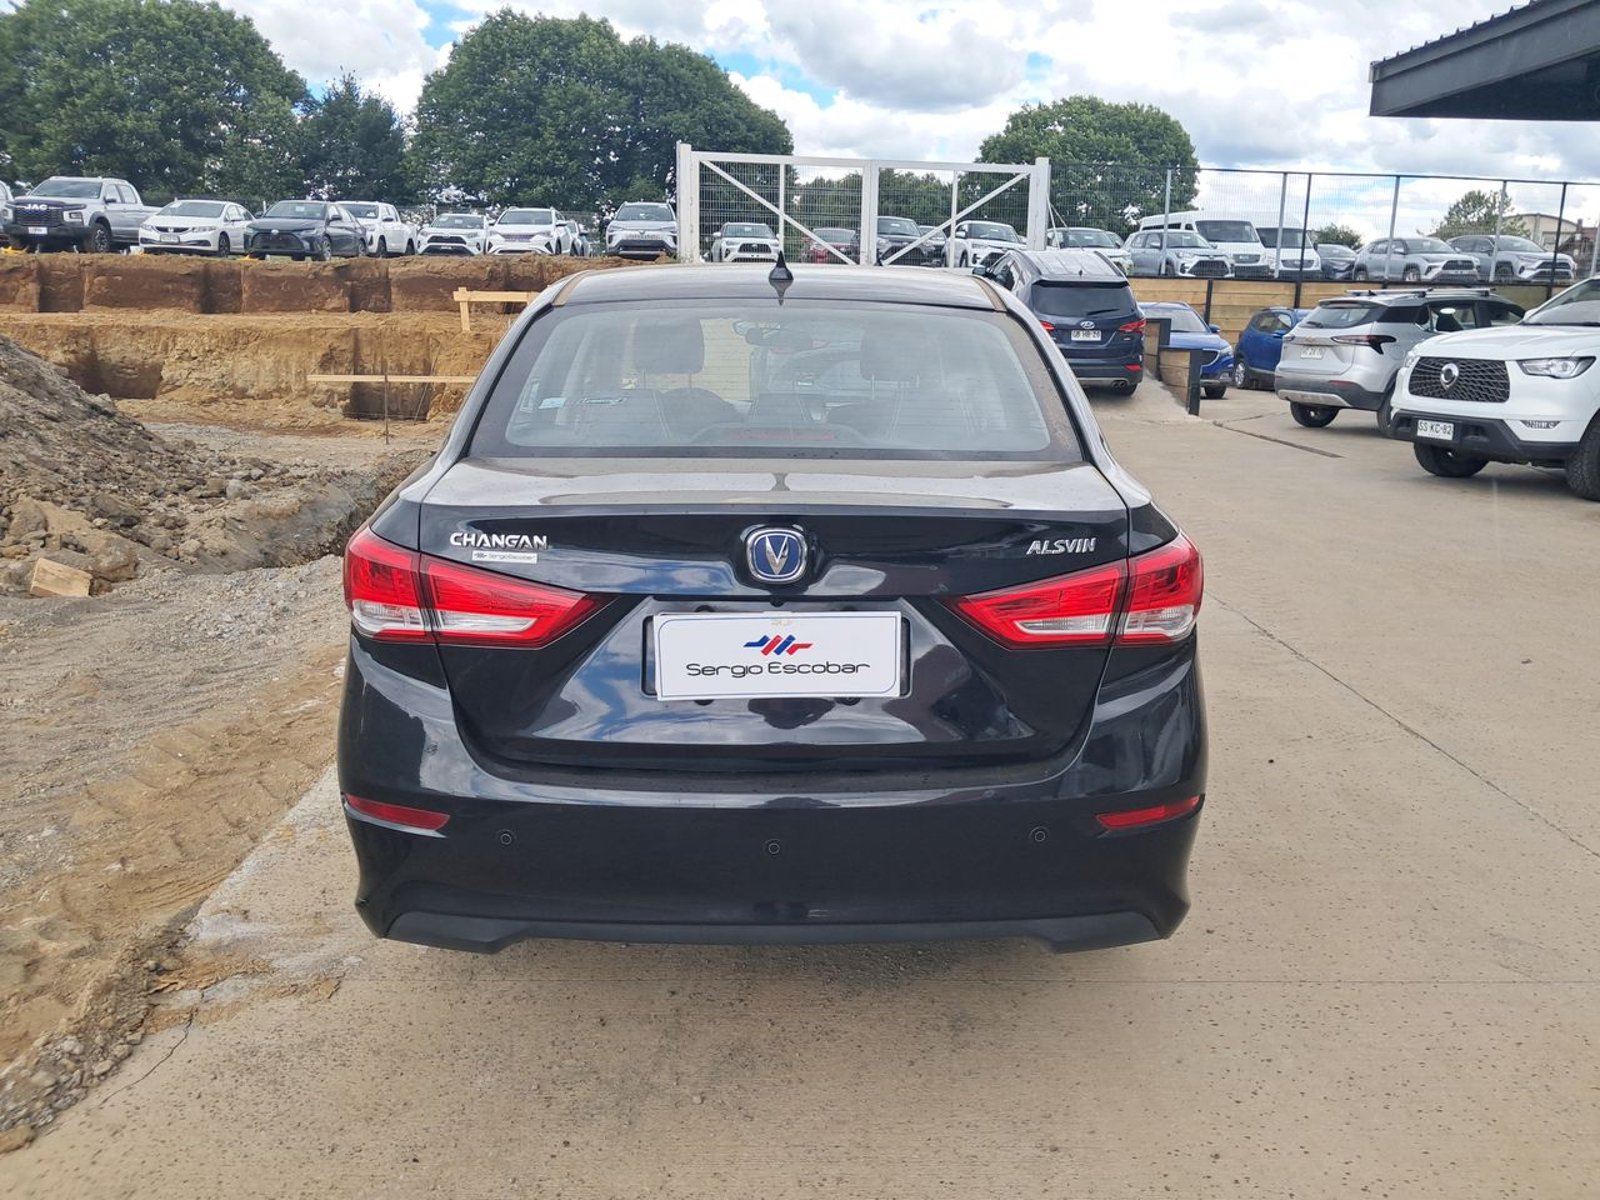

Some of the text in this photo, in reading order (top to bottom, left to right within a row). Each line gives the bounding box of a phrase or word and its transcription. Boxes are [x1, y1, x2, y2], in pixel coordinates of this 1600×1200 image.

[449, 532, 548, 550] CHANGAN
[1026, 537, 1097, 555] ALSVIN
[686, 661, 870, 678] Sergio Escobar
